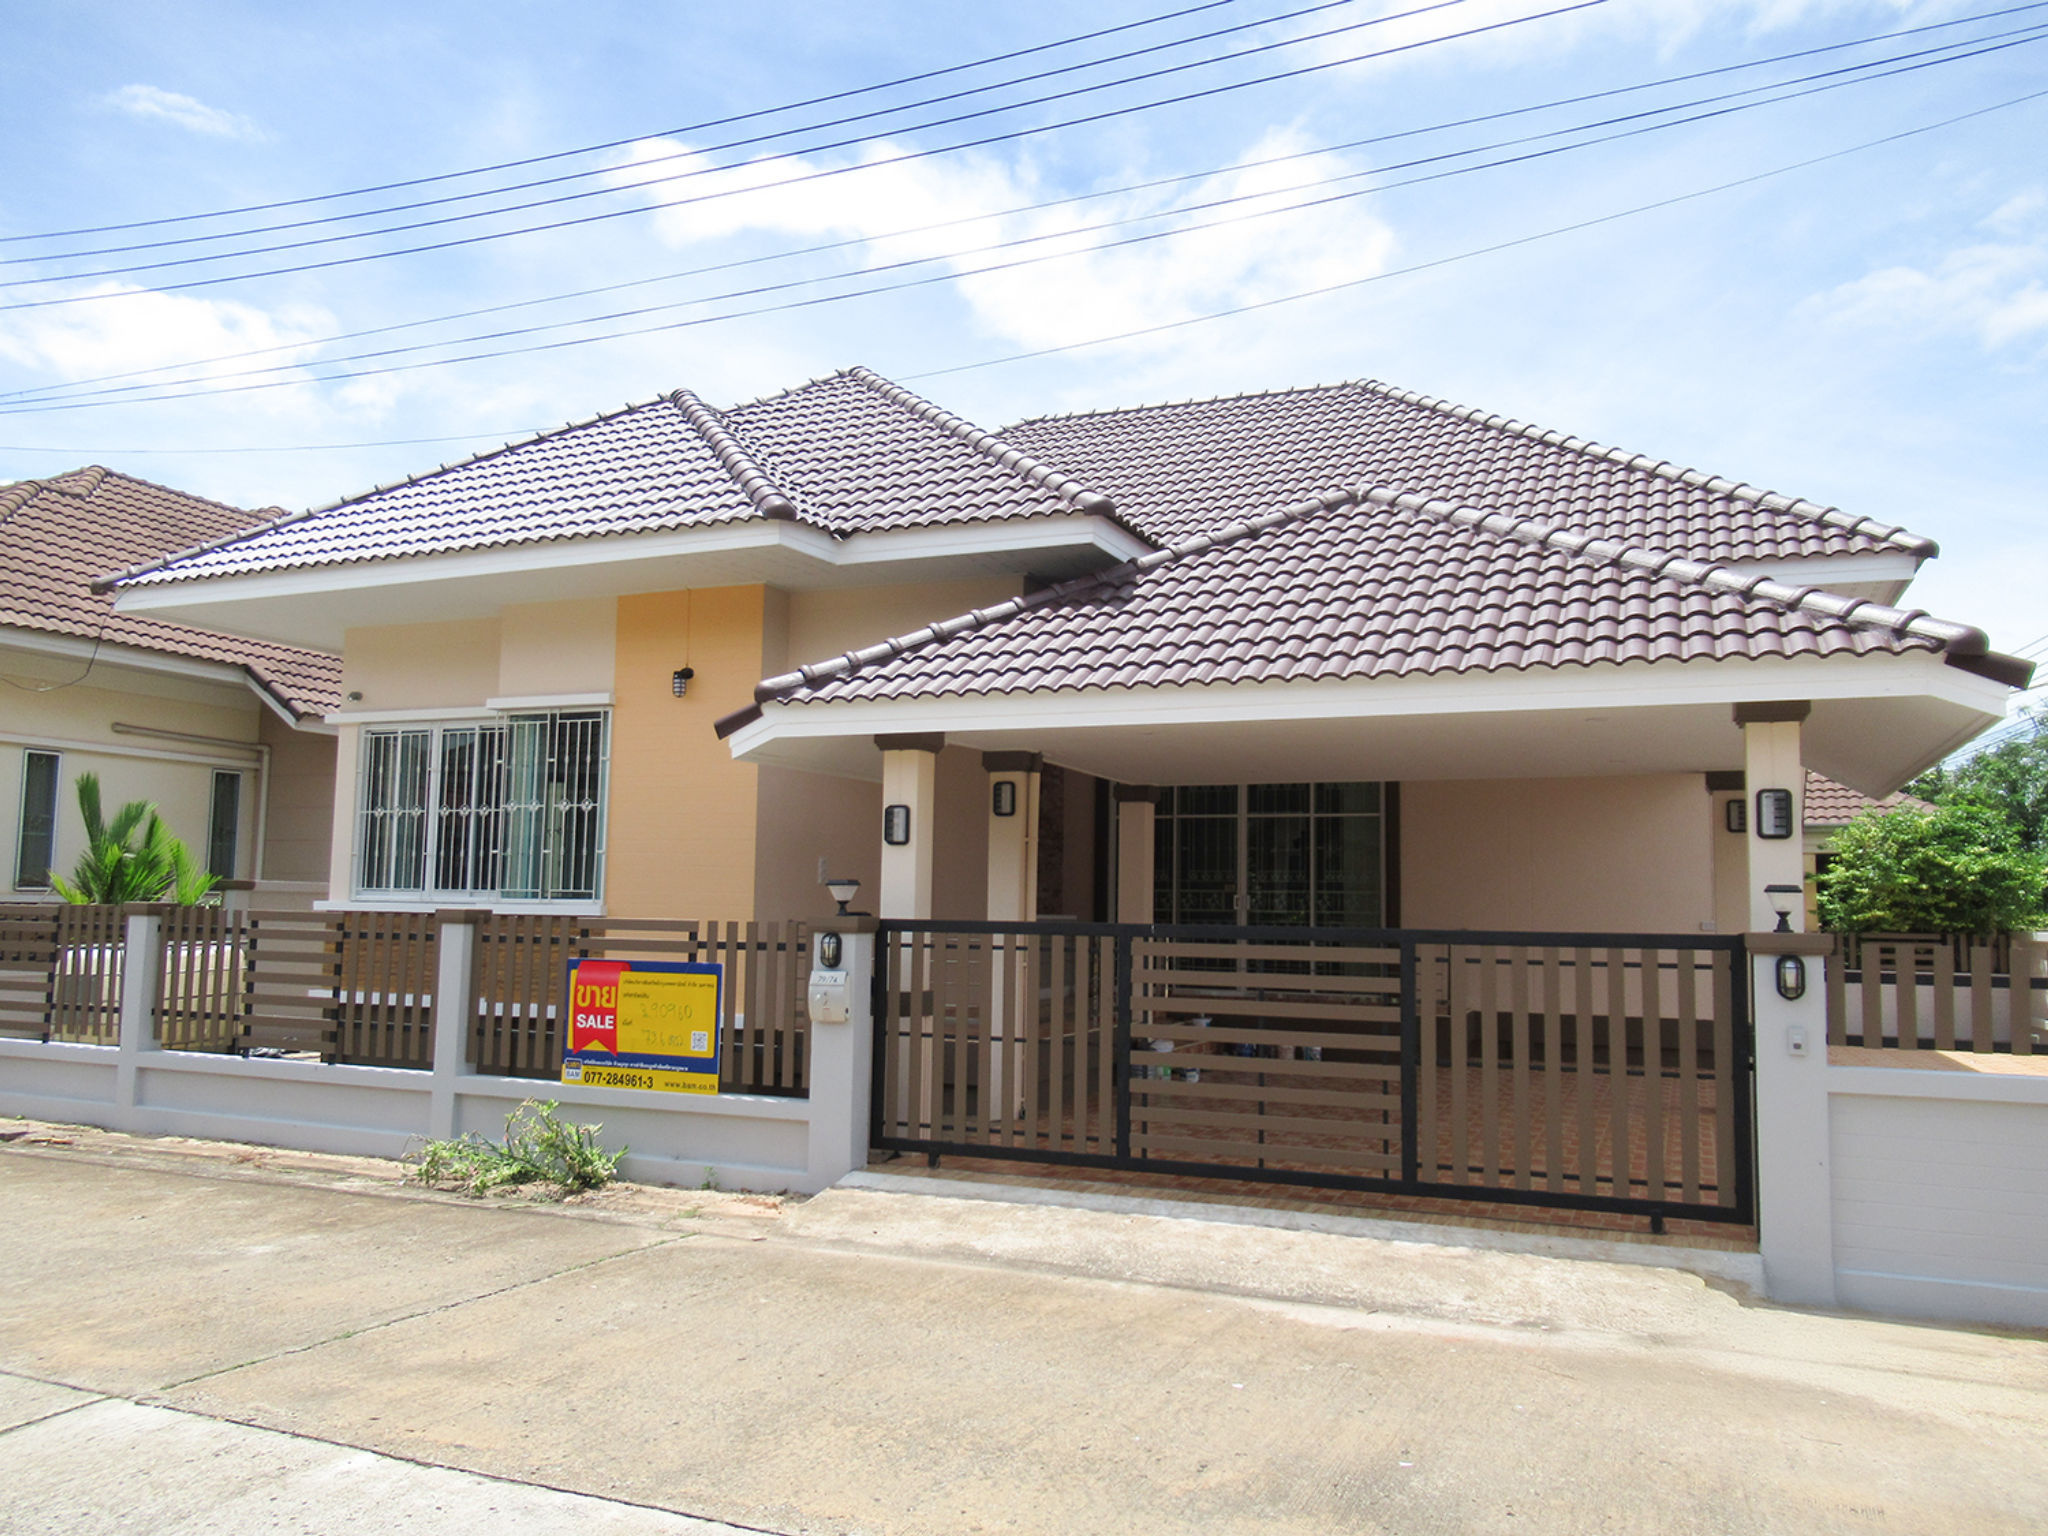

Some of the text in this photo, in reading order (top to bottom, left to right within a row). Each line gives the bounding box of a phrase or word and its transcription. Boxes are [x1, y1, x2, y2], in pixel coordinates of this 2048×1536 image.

[576, 985, 615, 1008] ขาย
[576, 1014, 615, 1029] SALE
[584, 1071, 654, 1089] 077-284961-3
[664, 1080, 716, 1091] www.bam.co.th
